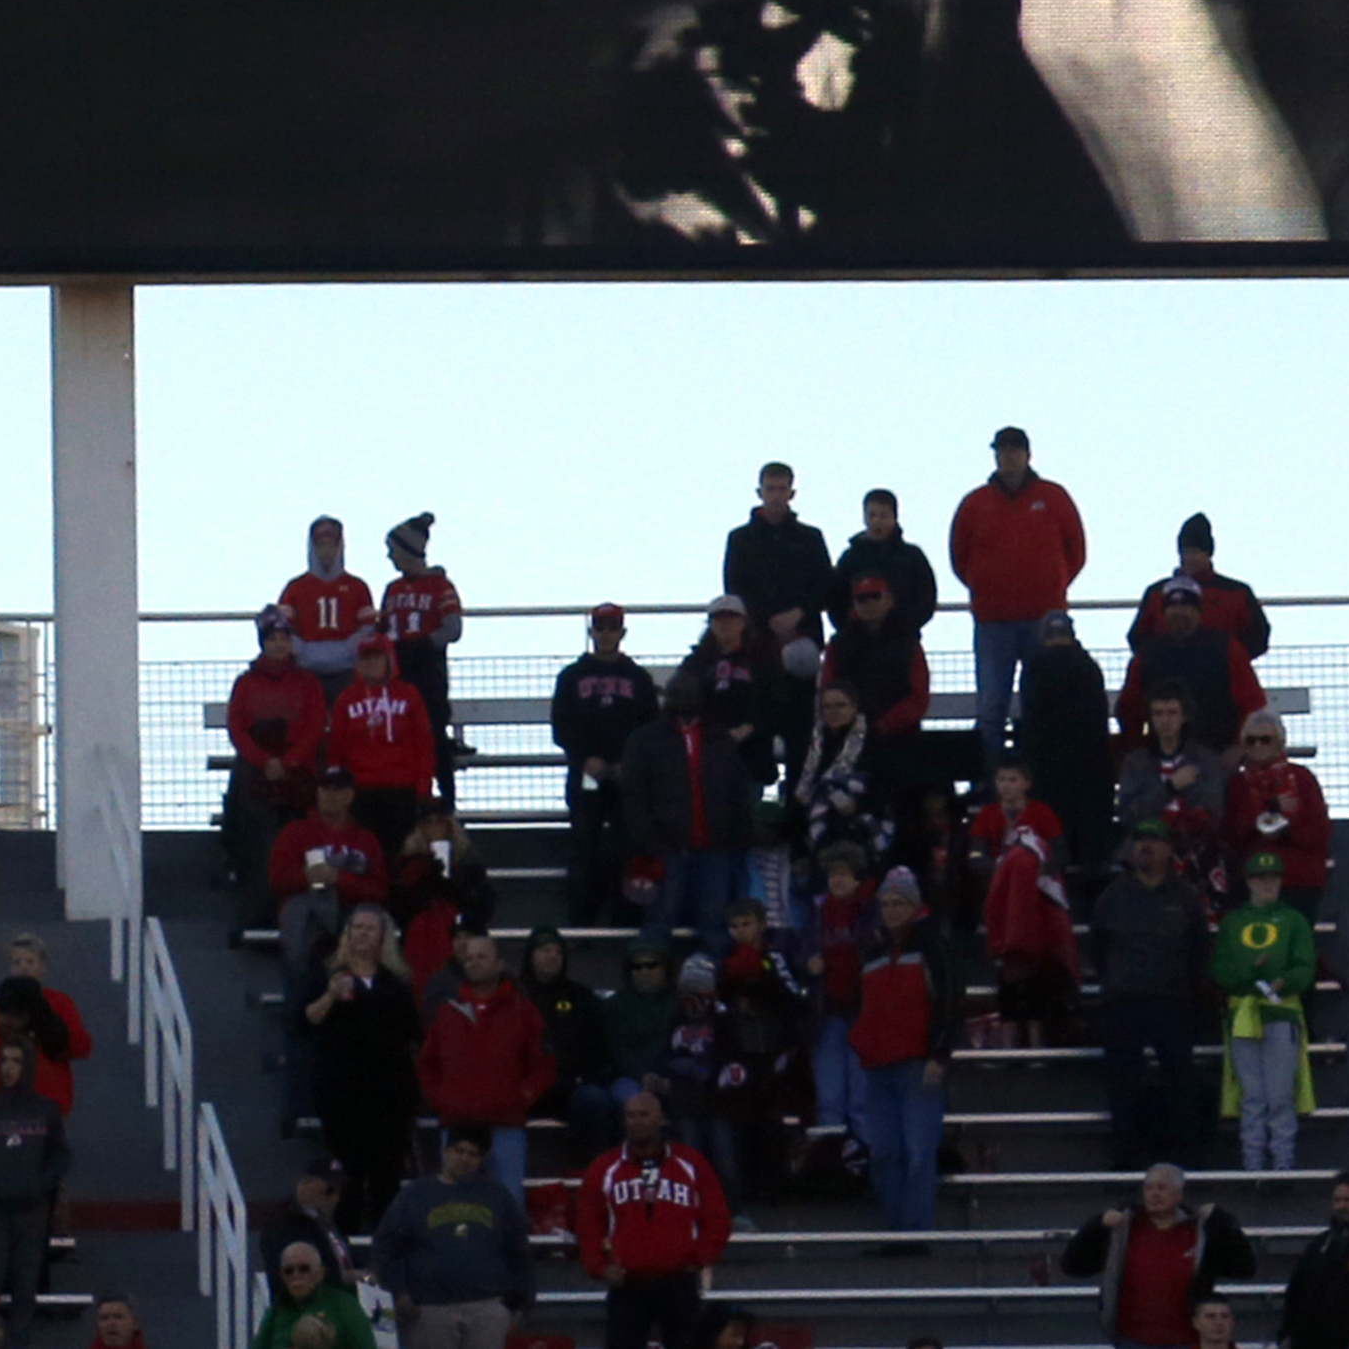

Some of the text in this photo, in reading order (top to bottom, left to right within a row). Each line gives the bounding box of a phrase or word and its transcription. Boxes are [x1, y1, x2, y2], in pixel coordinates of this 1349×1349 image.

[317, 596, 339, 629] 11
[347, 697, 408, 719] UTAH
[1240, 921, 1279, 950] O
[612, 1177, 690, 1208] UTAH
